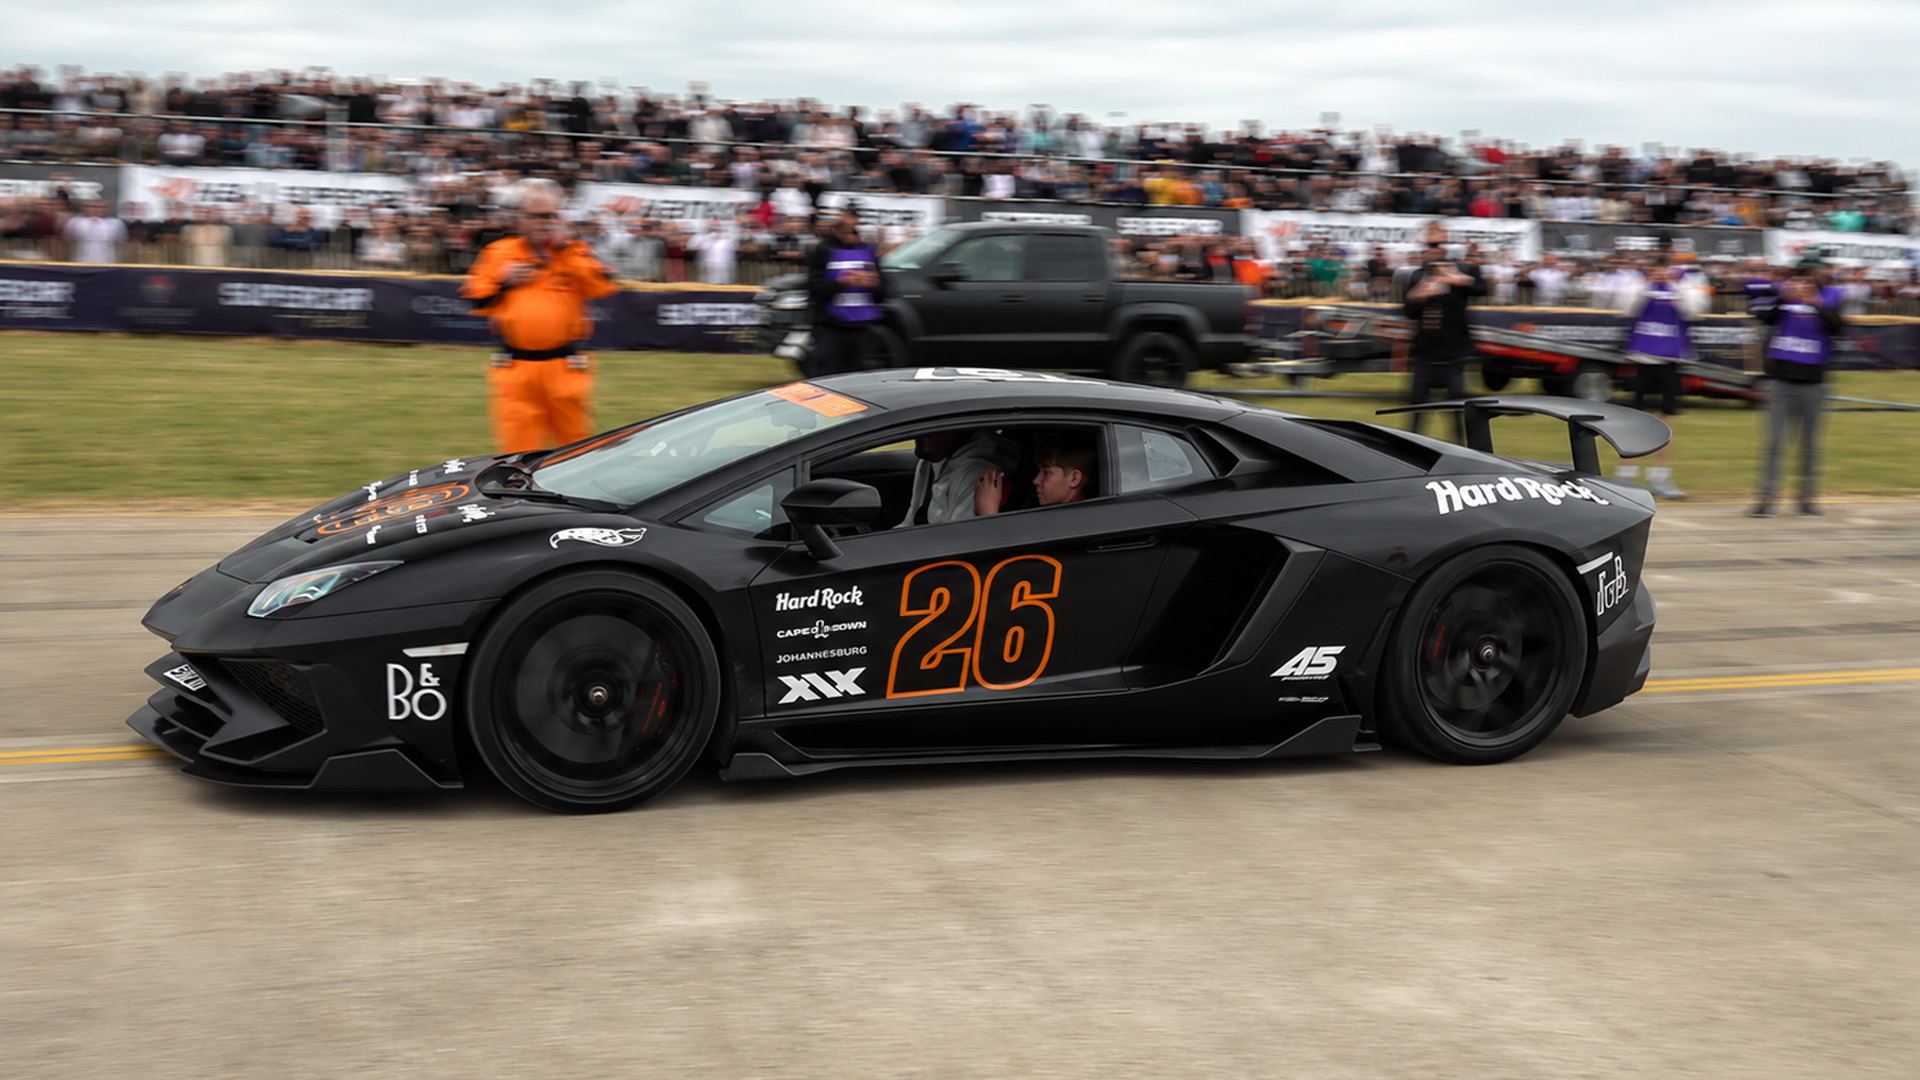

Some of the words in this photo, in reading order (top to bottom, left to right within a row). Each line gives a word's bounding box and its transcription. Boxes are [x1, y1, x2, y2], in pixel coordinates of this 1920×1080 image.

[1425, 476, 1524, 515] Hard
[1513, 477, 1610, 506] Rock
[775, 588, 820, 612] Hard
[821, 585, 864, 610] Rock
[886, 554, 1063, 699] 26
[776, 645, 868, 664] JOHANNESBURG
